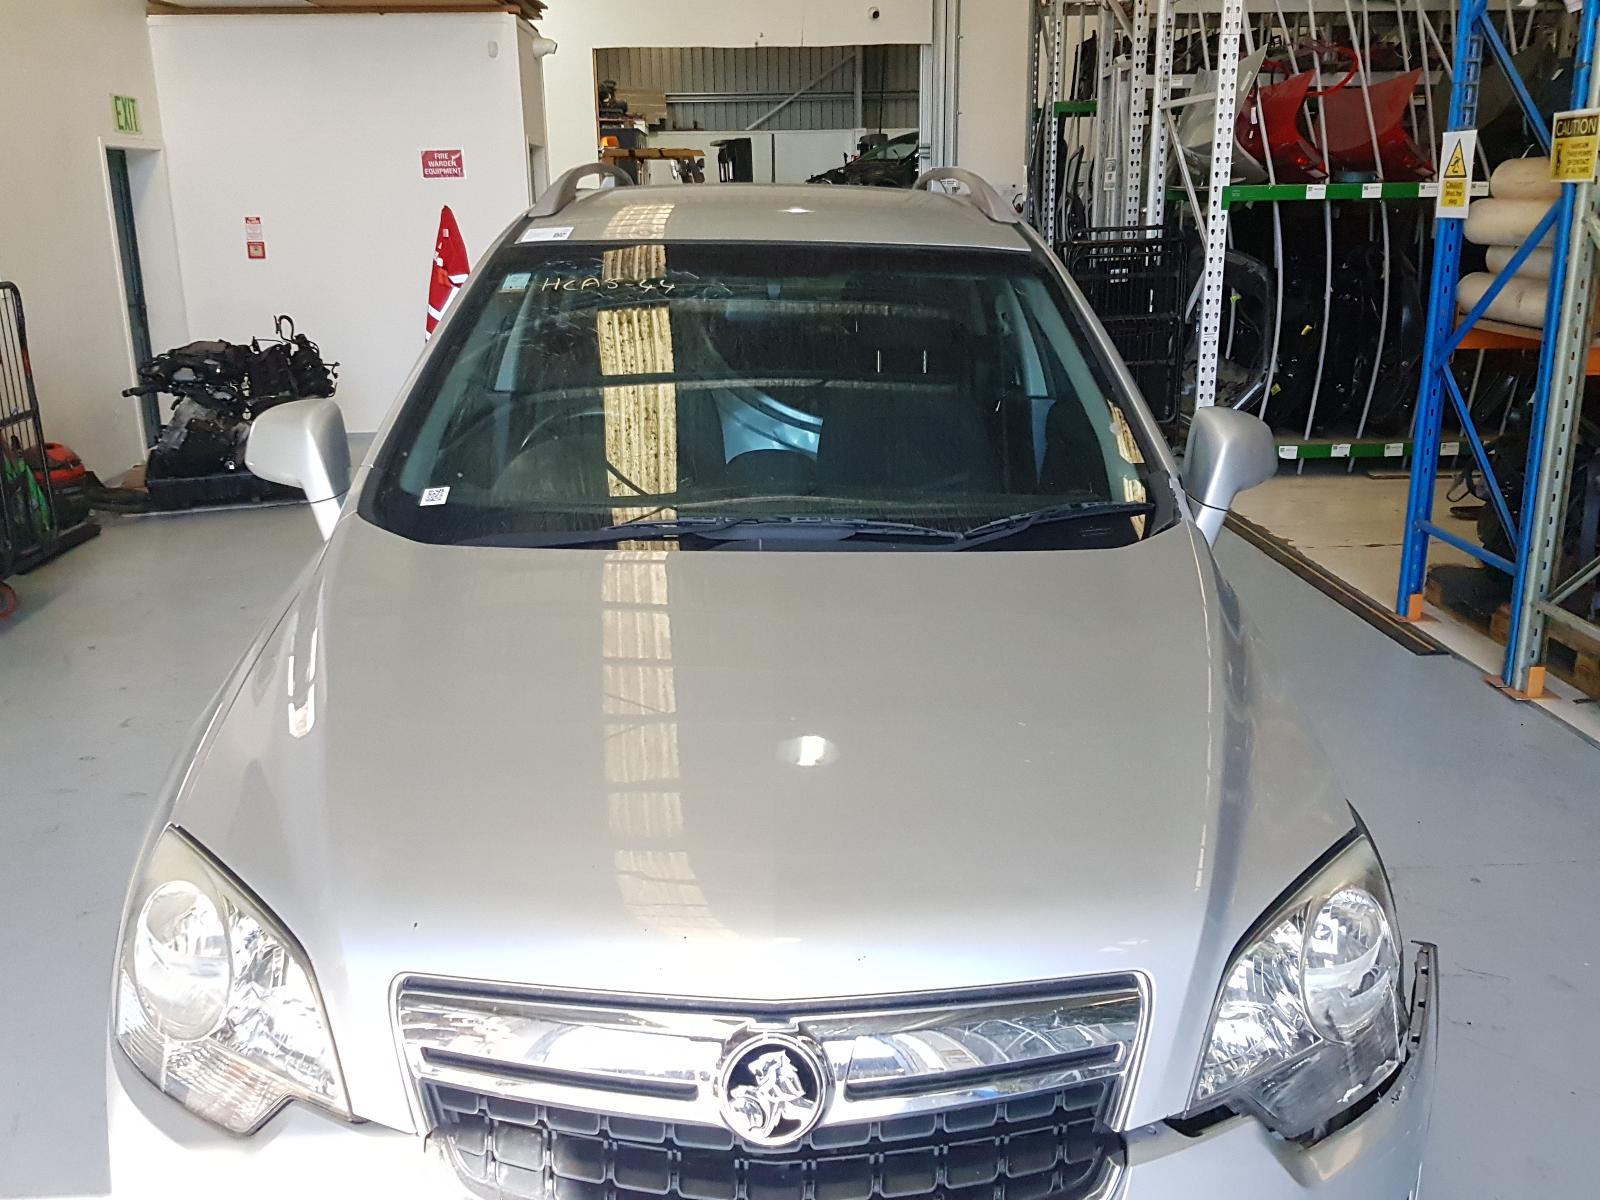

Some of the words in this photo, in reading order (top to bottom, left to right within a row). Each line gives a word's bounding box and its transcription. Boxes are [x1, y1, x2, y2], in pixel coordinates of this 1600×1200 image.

[113, 95, 138, 132] EXIT
[1556, 118, 1596, 136] CAUTION
[424, 167, 461, 175] EQUIPMENT
